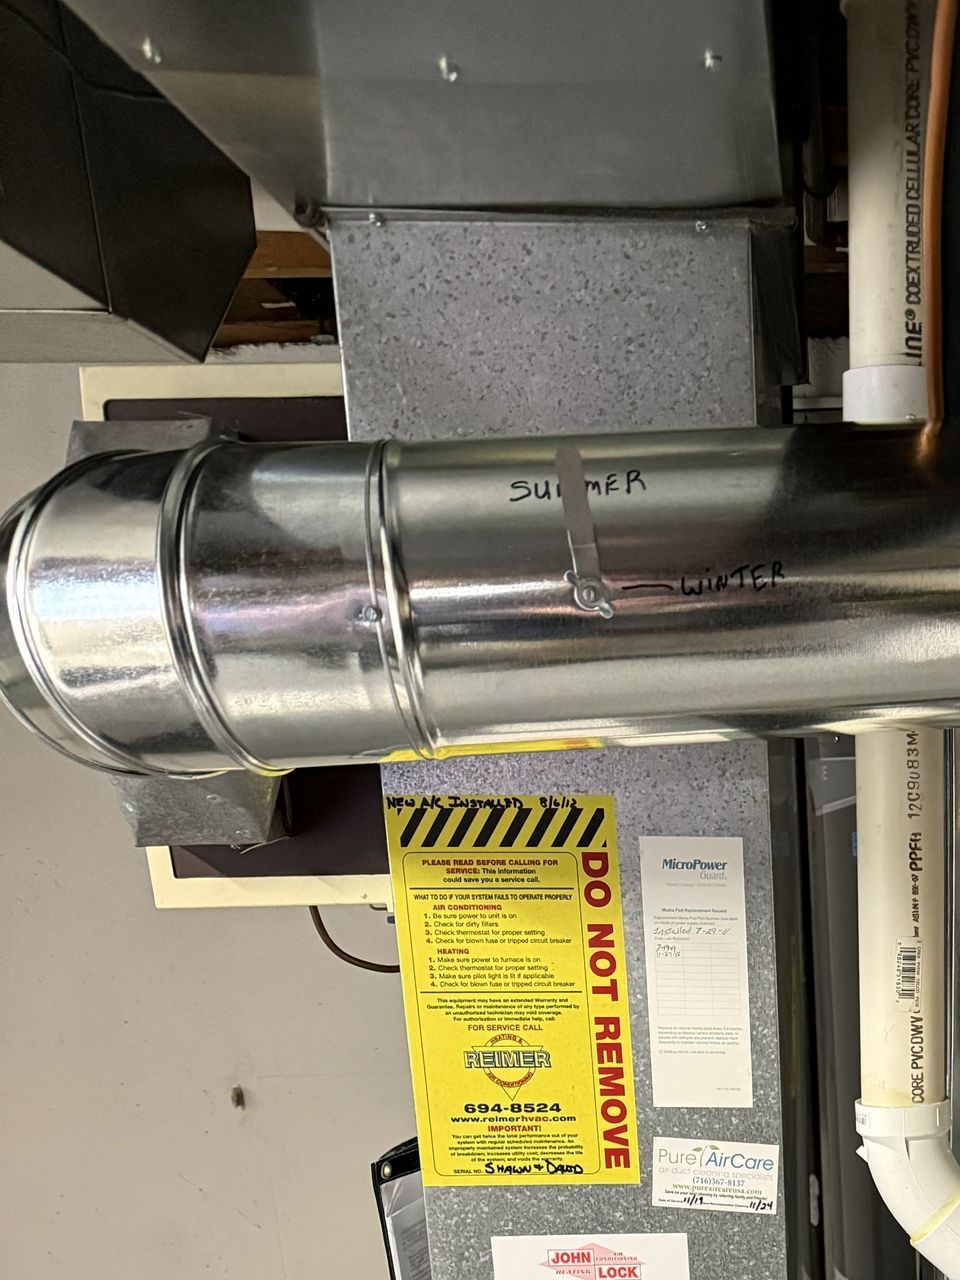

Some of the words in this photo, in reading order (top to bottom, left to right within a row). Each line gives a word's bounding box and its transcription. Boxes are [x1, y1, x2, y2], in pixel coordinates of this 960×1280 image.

[906, 204, 922, 305] COEXTRUDED
[510, 469, 646, 501] SUMER
[681, 561, 784, 596] WINTER
[386, 797, 416, 809] NEW
[421, 796, 443, 809] A/C
[449, 797, 523, 809] INSTALLED
[662, 858, 727, 870] MicroPower
[581, 852, 613, 908] DO
[587, 924, 619, 1001] NOT
[464, 1051, 552, 1069] REIMER
[594, 1017, 631, 1169] REMOVE
[912, 1072, 924, 1104] CORE
[464, 1103, 561, 1113] 694-8524
[659, 1149, 696, 1165] Pure
[705, 1152, 774, 1170] AirCare
[552, 1252, 591, 1264] JOHN
[598, 1266, 638, 1279] LOCK
